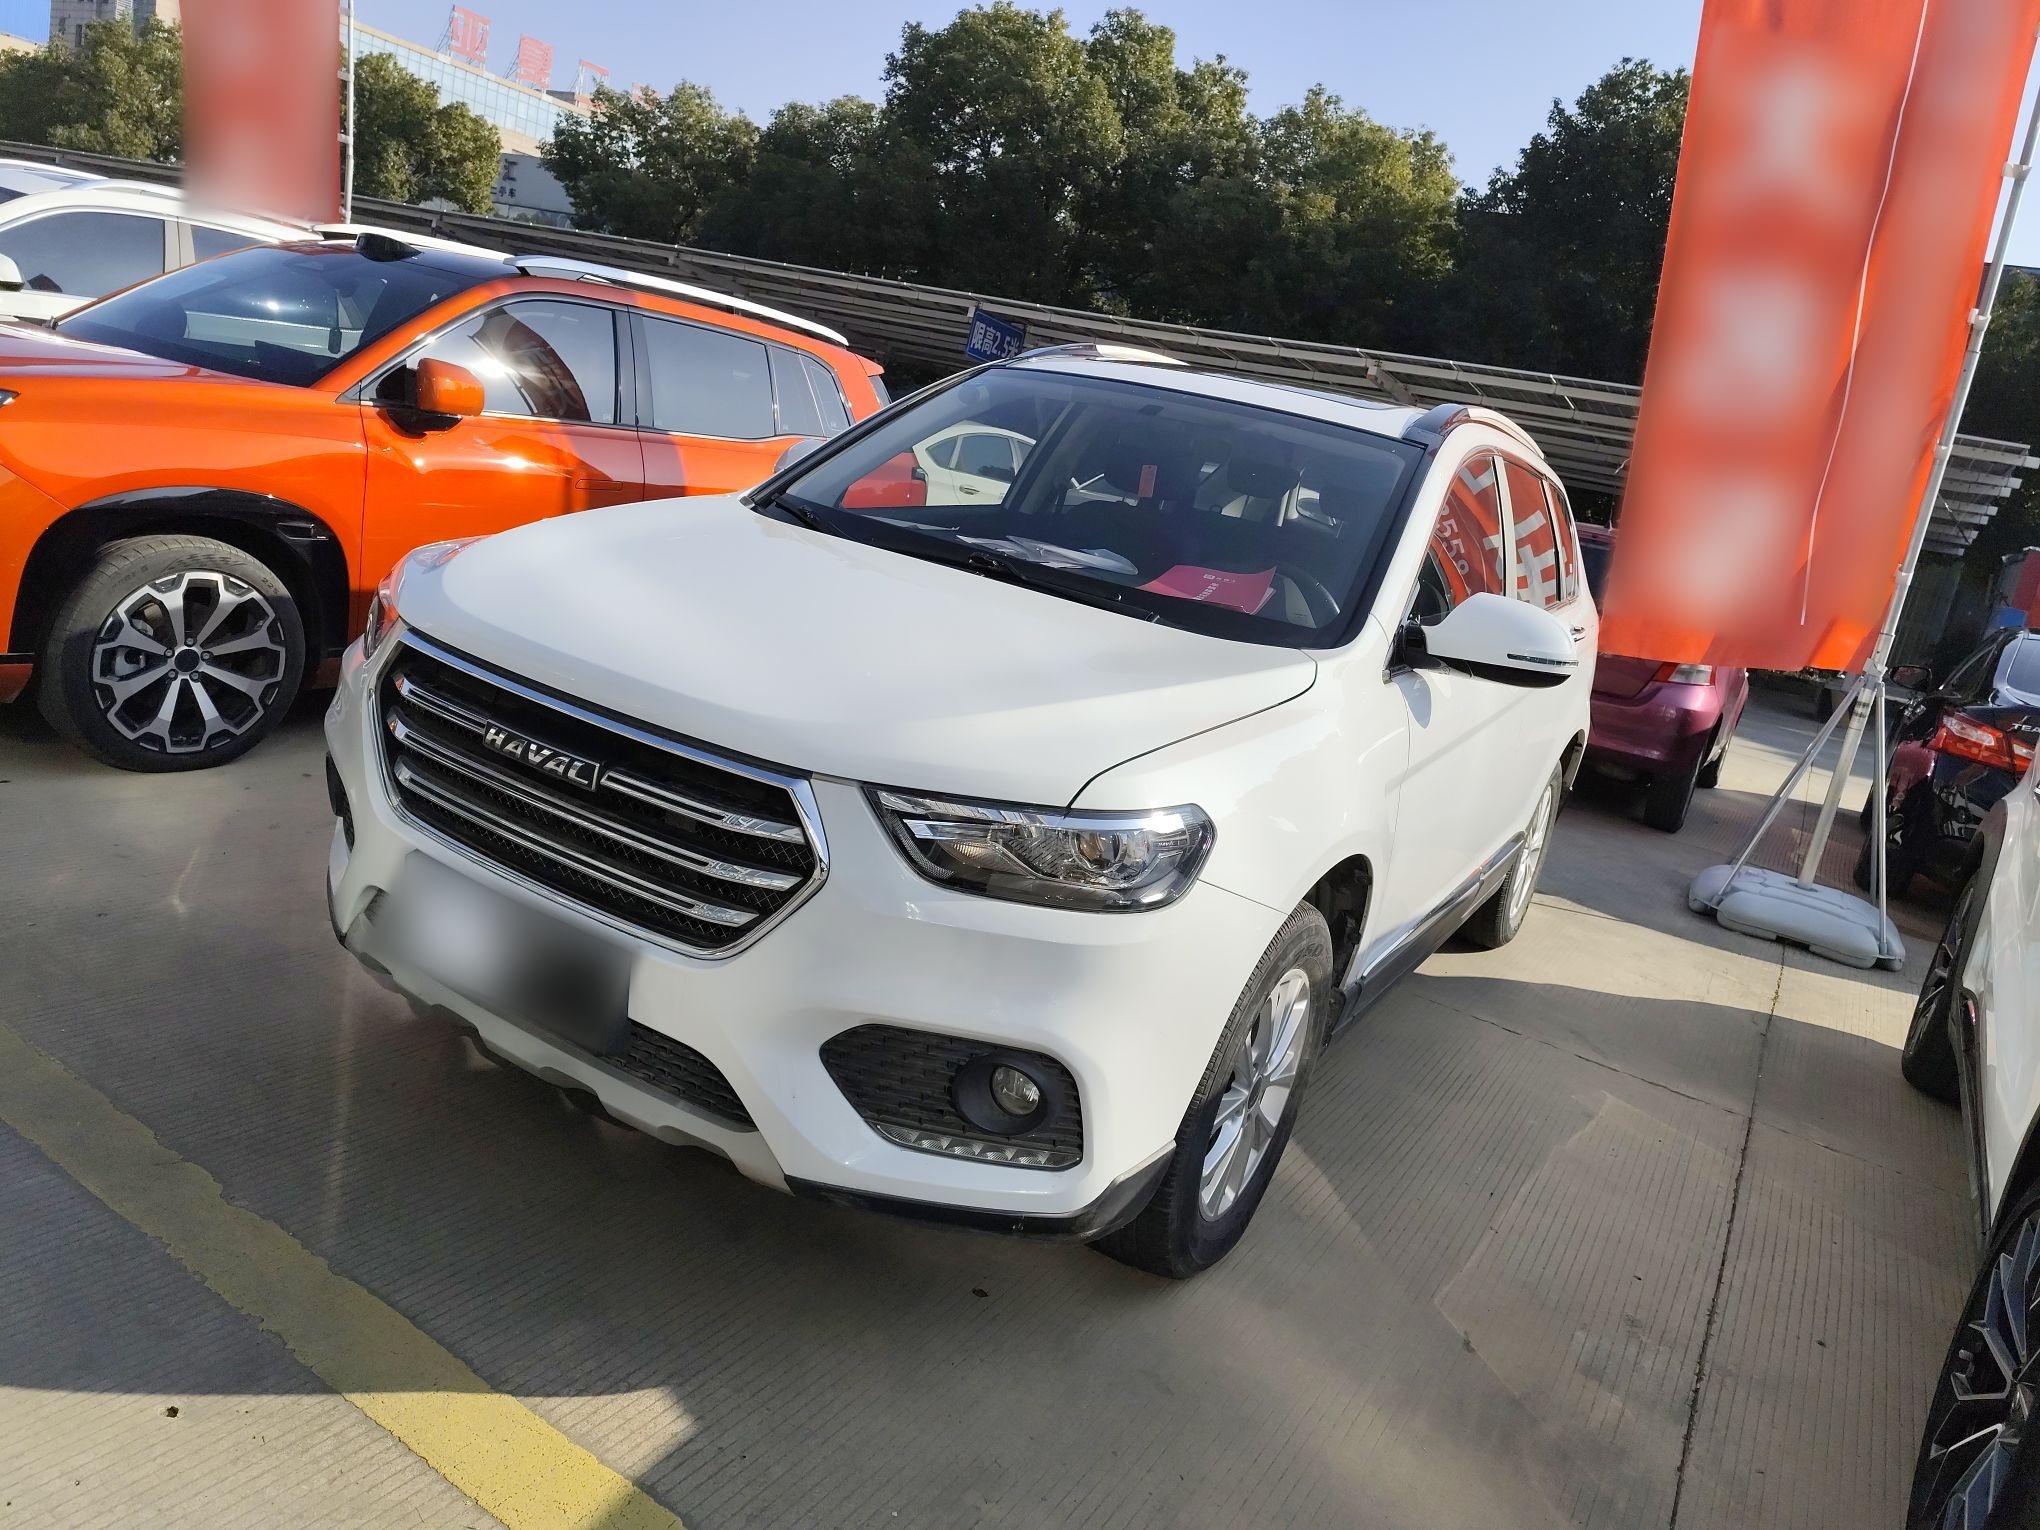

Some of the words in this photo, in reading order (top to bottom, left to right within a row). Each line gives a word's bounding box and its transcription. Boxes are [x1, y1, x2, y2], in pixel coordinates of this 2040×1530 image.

[970, 321, 1019, 358] 限高2.5米
[485, 726, 589, 785] HAVAL
